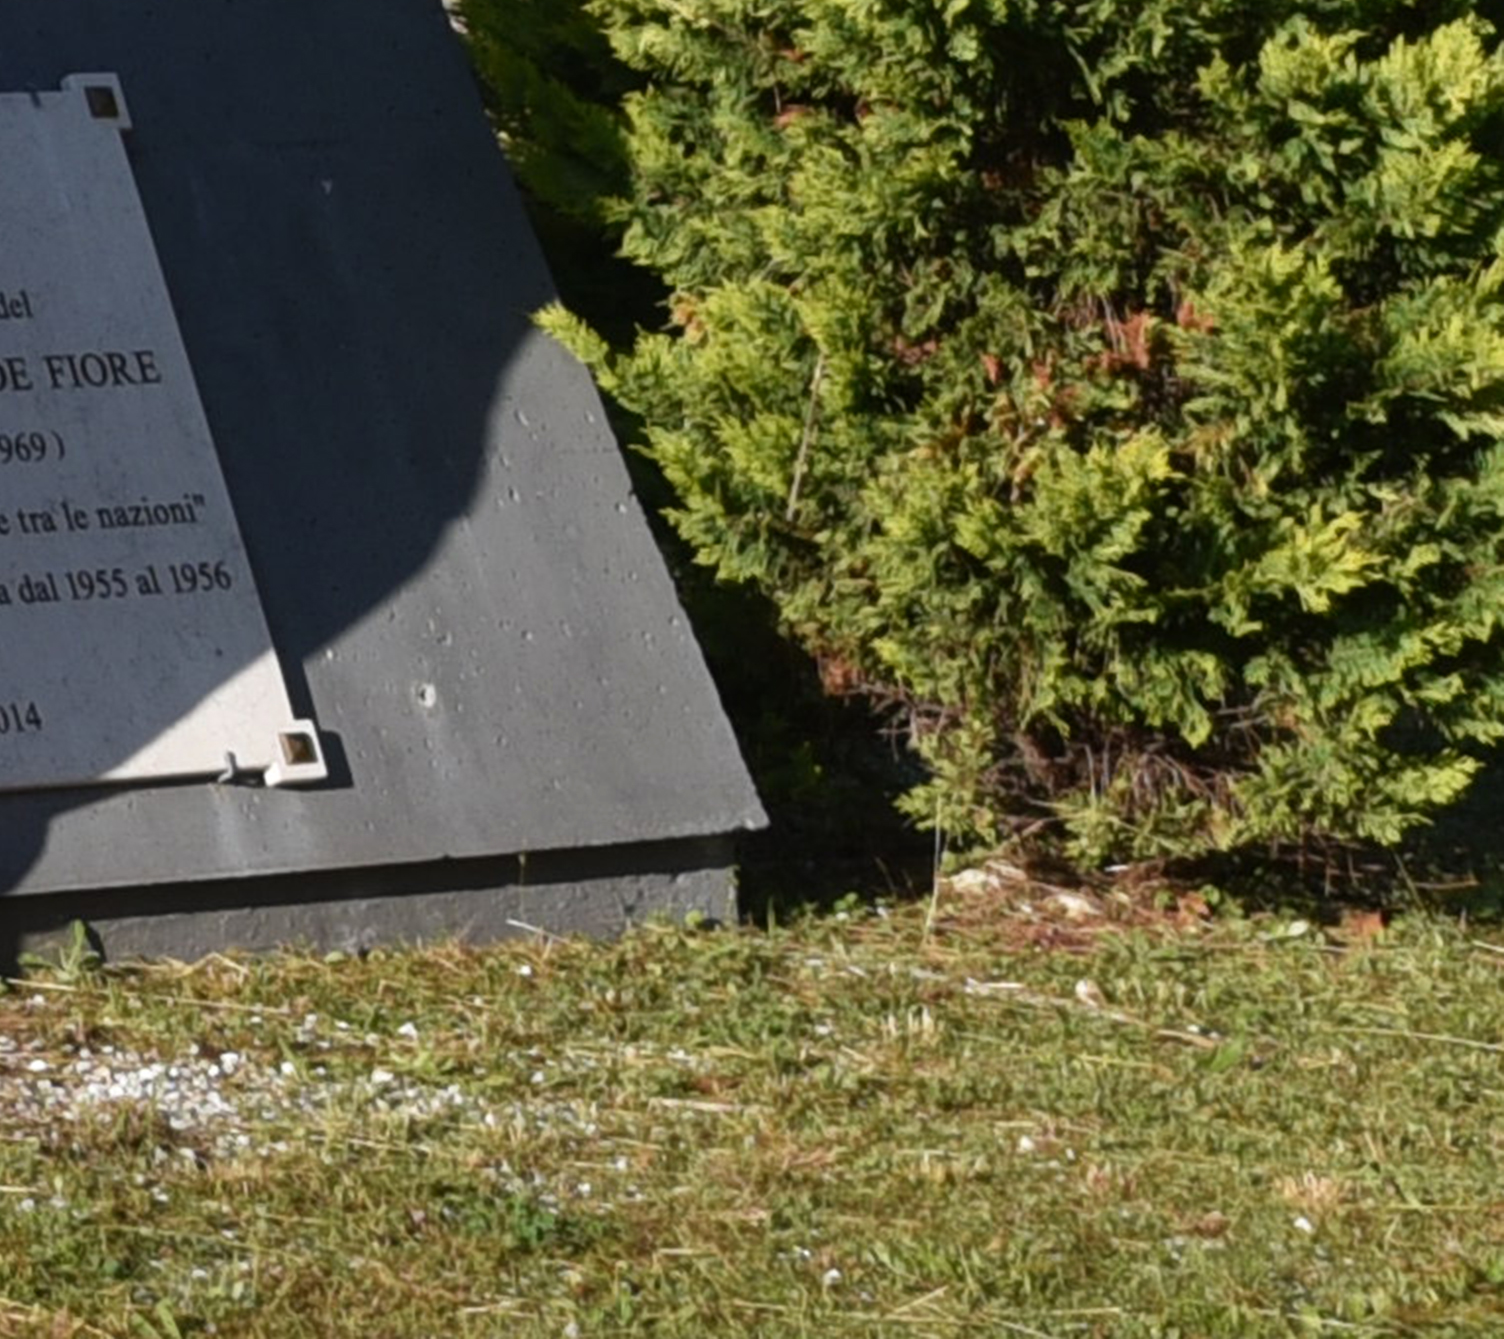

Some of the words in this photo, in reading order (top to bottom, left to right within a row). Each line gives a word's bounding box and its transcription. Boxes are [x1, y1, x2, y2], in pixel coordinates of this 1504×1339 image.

[42, 349, 164, 391] FIORE
[16, 507, 57, 536] tra
[62, 500, 89, 531] le
[97, 492, 207, 530] nazioni"
[18, 572, 61, 604] dal
[65, 568, 129, 601] 1955
[136, 564, 162, 595] al
[169, 559, 233, 594] 1956
